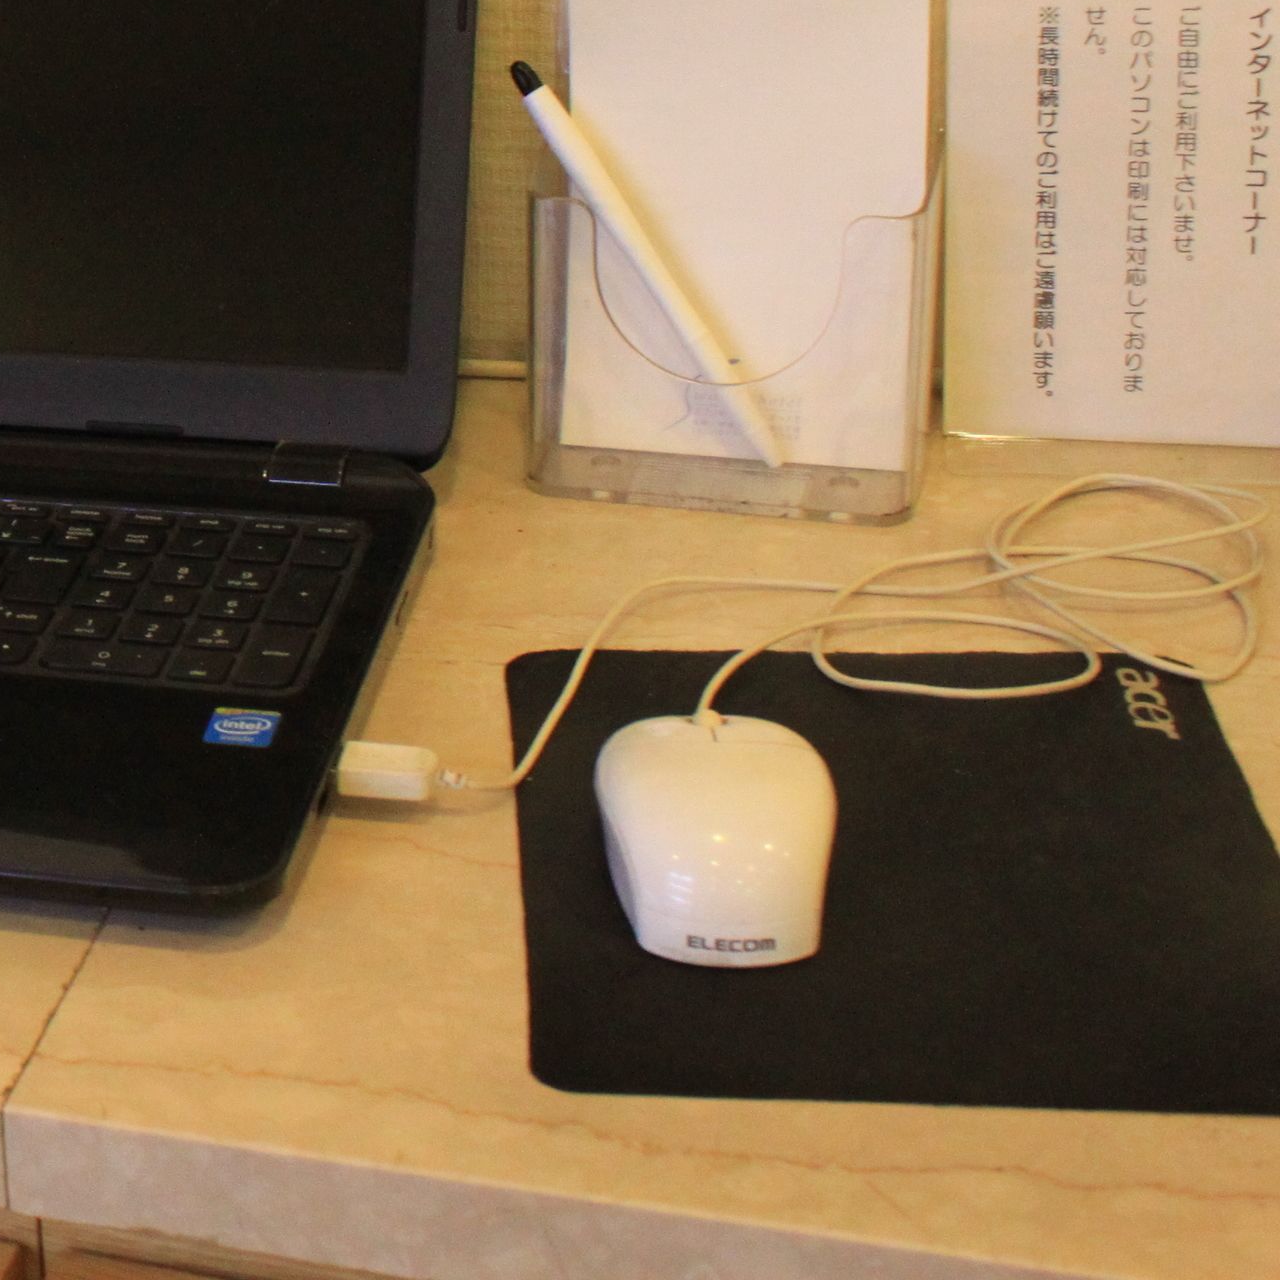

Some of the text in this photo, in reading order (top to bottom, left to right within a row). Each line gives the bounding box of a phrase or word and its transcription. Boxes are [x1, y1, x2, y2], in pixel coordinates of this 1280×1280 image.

[1172, 6, 1202, 263] ご自由にご利用下さいませ。
[1242, 7, 1273, 256] インターネットコーナー
[1116, 667, 1181, 741] acer
[686, 933, 778, 954] ELECOM
